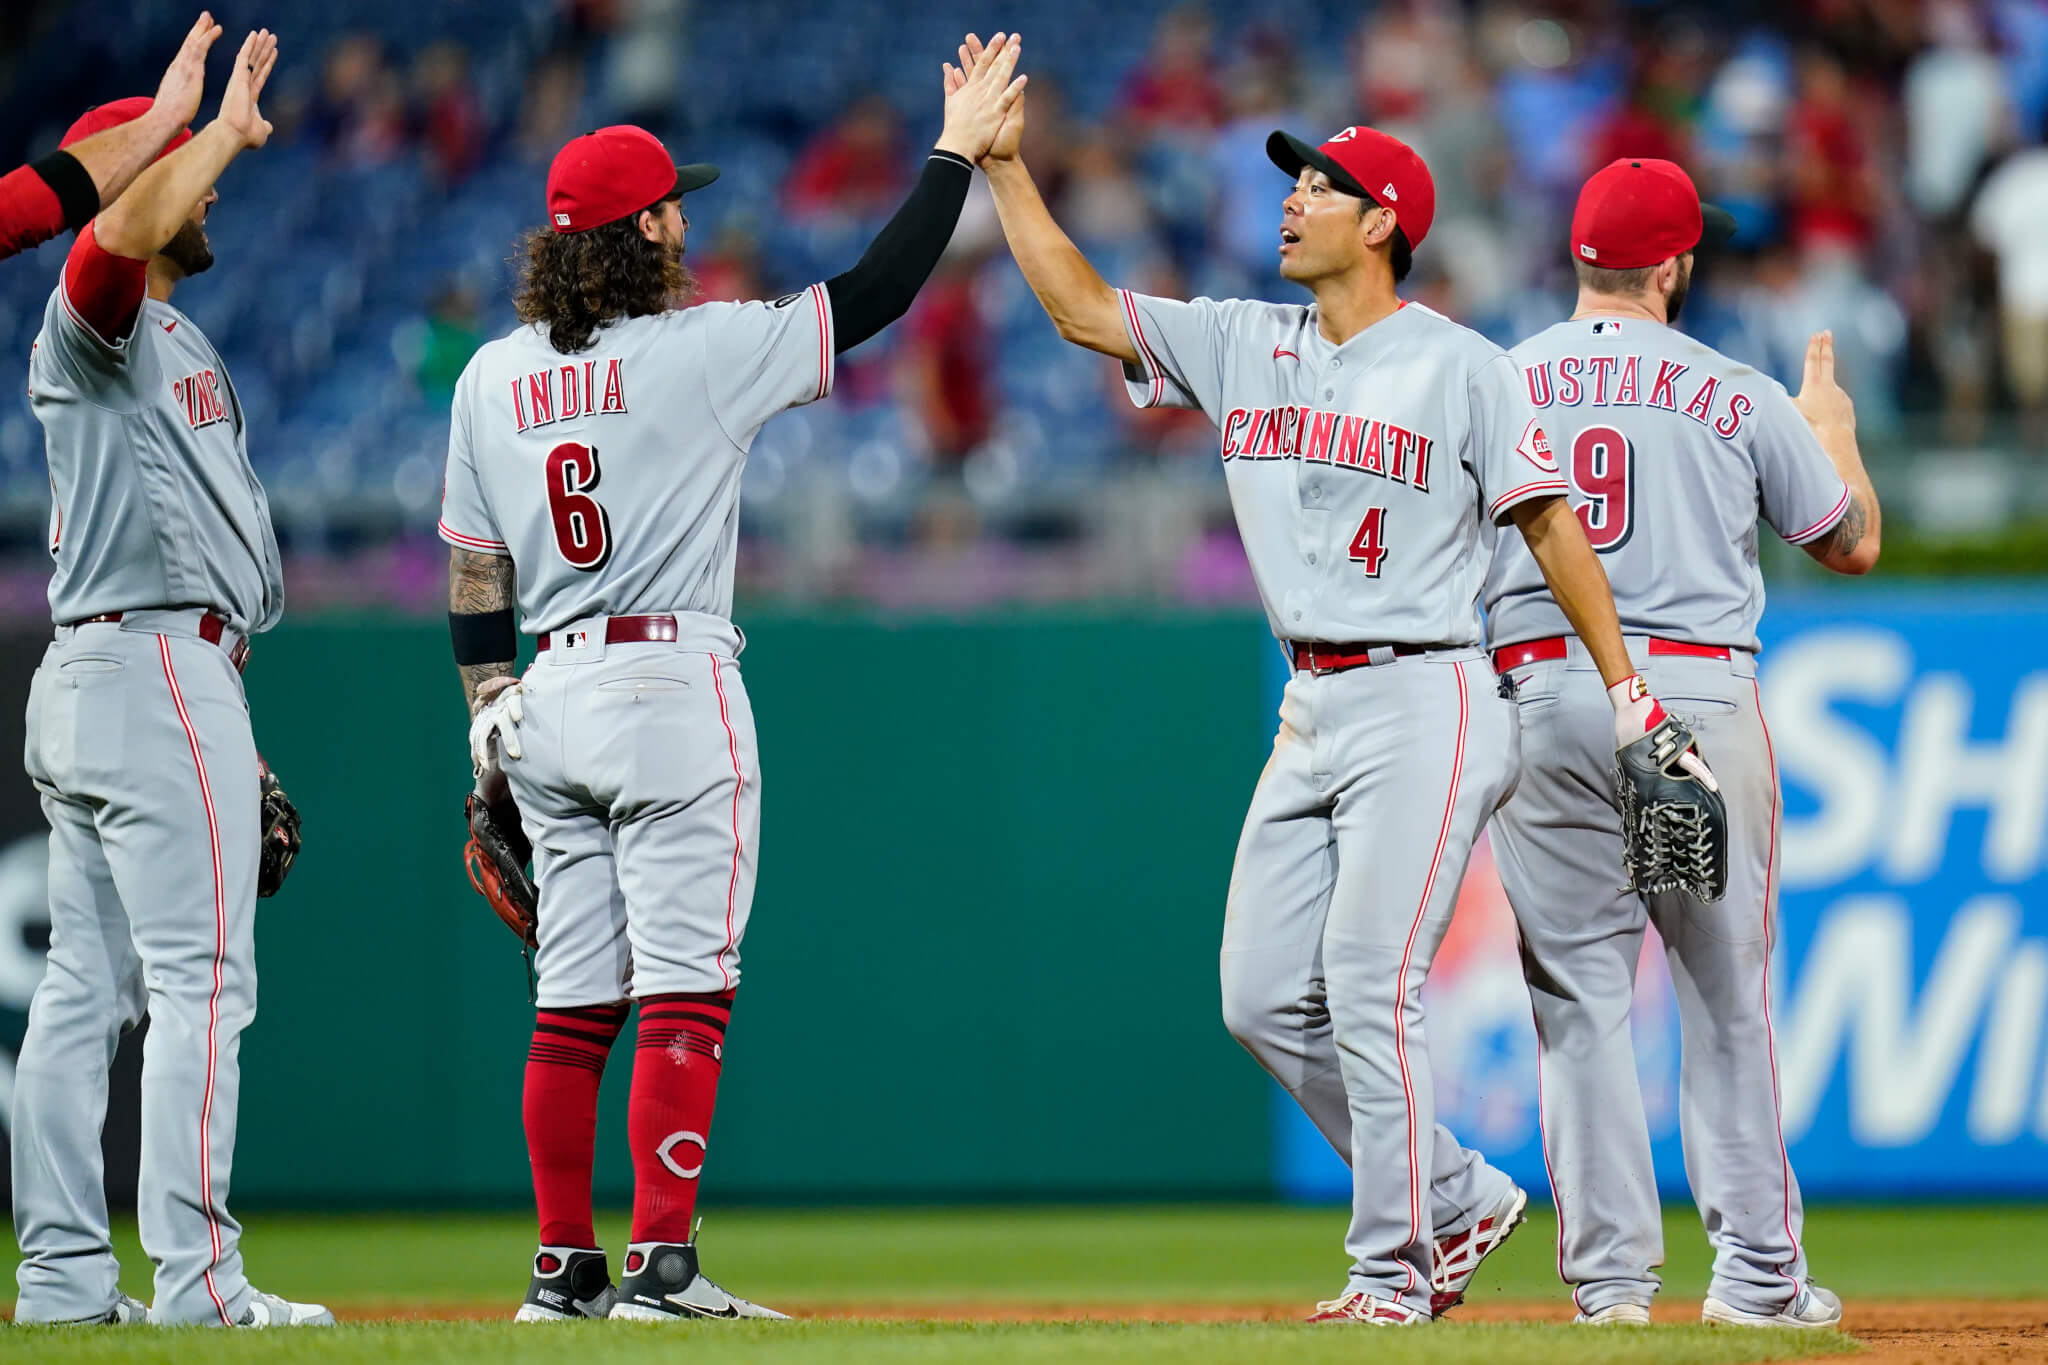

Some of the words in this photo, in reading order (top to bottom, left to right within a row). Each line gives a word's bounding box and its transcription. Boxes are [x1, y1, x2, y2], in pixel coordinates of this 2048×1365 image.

[173, 368, 230, 431] CINC
[510, 357, 628, 433] INDIA
[1221, 405, 1434, 494] CINCINNATI
[1570, 424, 1634, 554] 9
[544, 440, 613, 572] 6
[1348, 506, 1389, 579] 4
[1774, 892, 2048, 1147] WI
[655, 1130, 707, 1180] C
